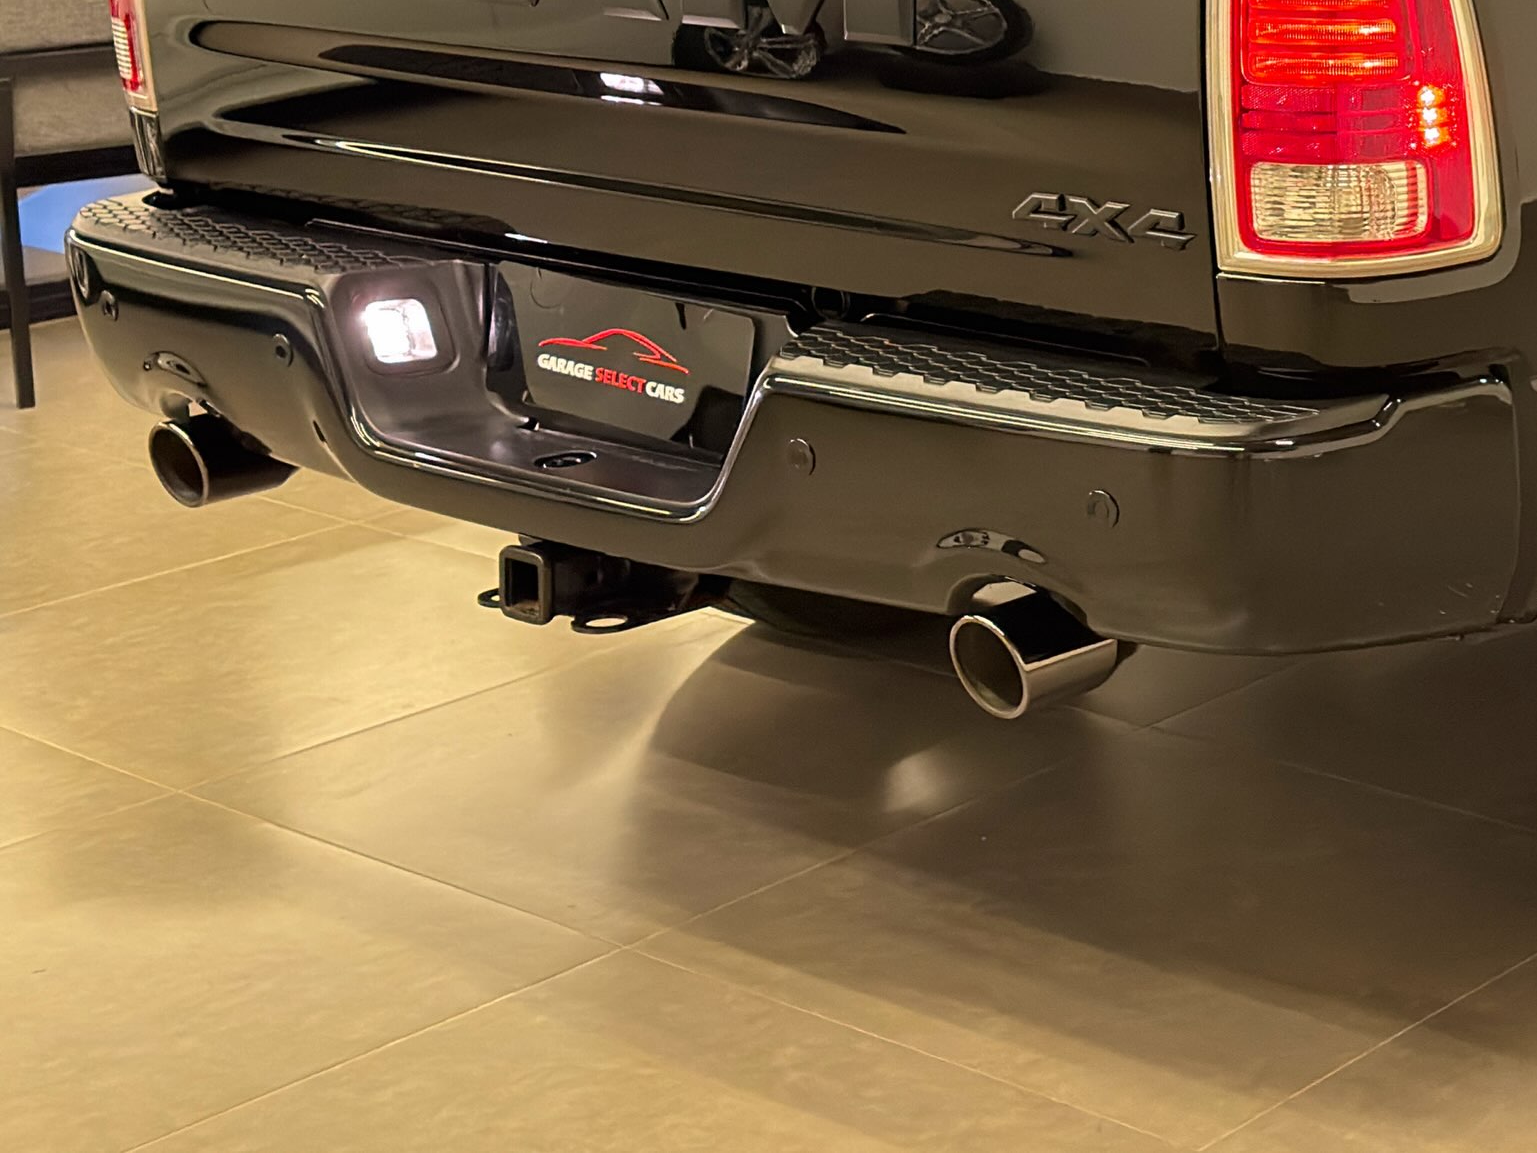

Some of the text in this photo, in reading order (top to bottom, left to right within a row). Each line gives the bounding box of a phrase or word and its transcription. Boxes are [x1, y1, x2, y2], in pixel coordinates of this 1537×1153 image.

[537, 352, 686, 405] GARAGE SELECT CARS
